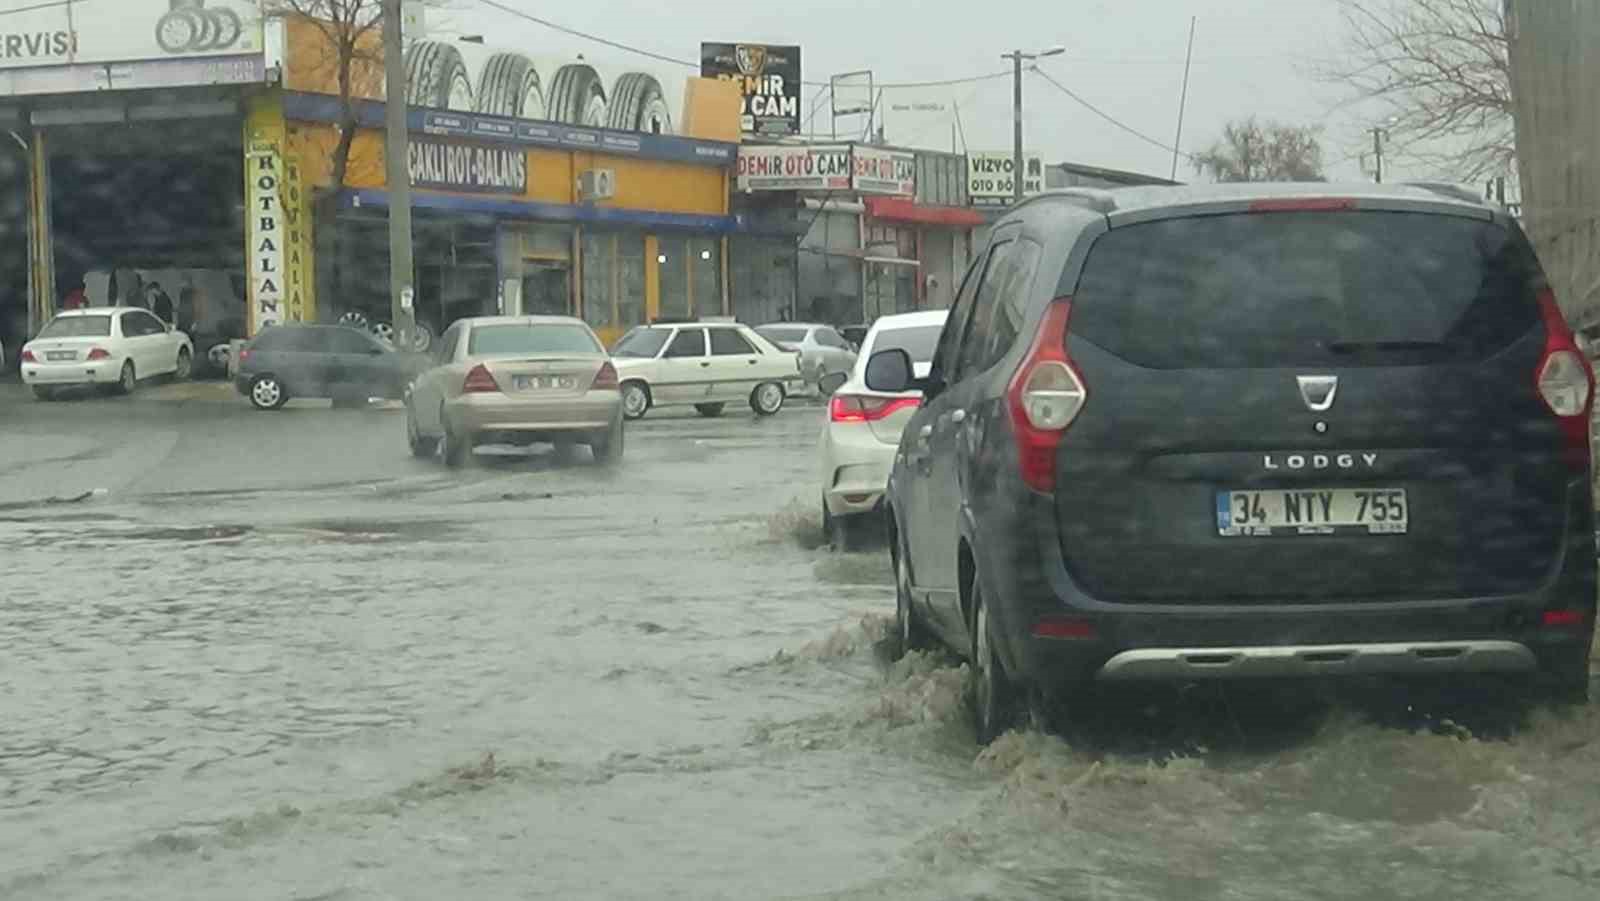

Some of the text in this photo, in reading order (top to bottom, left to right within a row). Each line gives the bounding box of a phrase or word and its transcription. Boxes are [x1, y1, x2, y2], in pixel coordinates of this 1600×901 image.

[751, 96, 797, 117] CAM
[785, 154, 814, 175] OTO
[816, 154, 849, 175] CAM
[1263, 453, 1377, 469] LODGY
[1232, 490, 1404, 524] 34 NTY 755
